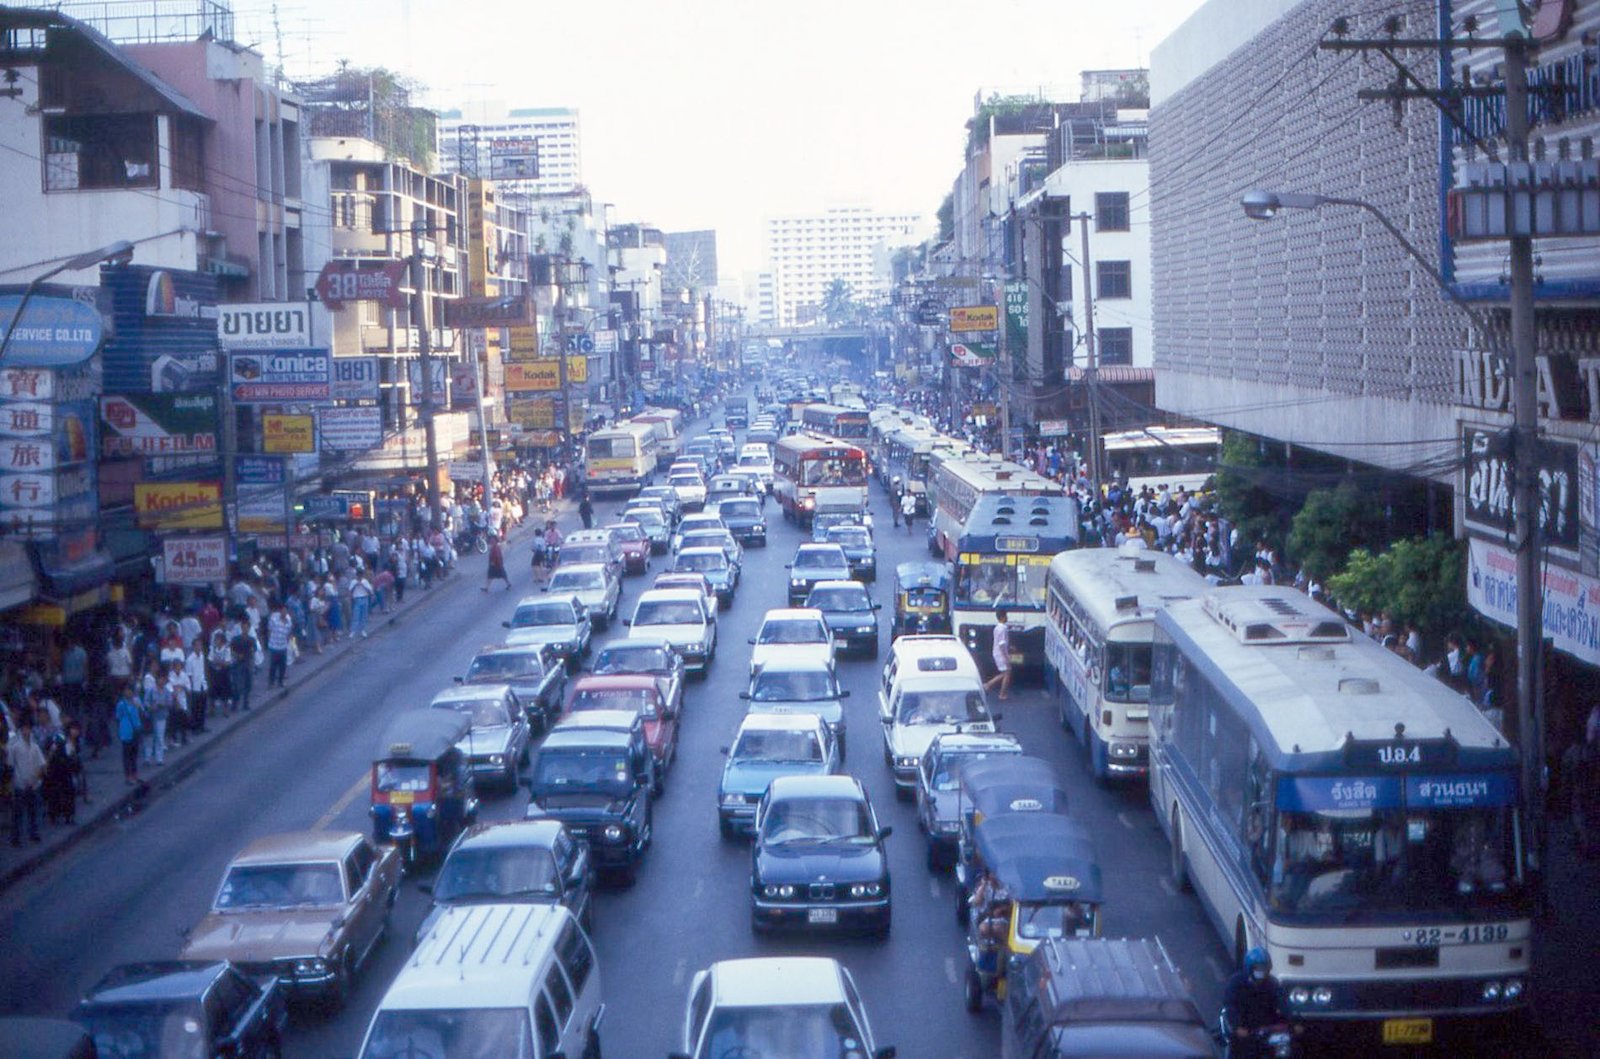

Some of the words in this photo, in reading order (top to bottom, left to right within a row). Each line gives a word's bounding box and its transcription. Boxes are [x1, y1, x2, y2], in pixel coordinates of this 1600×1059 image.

[328, 272, 357, 298] 38
[223, 310, 304, 335] ขายยา
[967, 313, 993, 321] Kodak
[10, 328, 53, 341] SERVICE
[262, 353, 328, 373] Konica
[524, 369, 556, 380] Kodak
[296, 385, 328, 397] SERVICE
[146, 490, 213, 511] Kodak
[172, 550, 197, 567] 45
[199, 555, 219, 567] min
[1378, 745, 1421, 764] ป.อ.4
[1330, 781, 1377, 800] รังสิต
[1419, 780, 1488, 798] สวนธนฯ
[1052, 878, 1074, 887] TAXI
